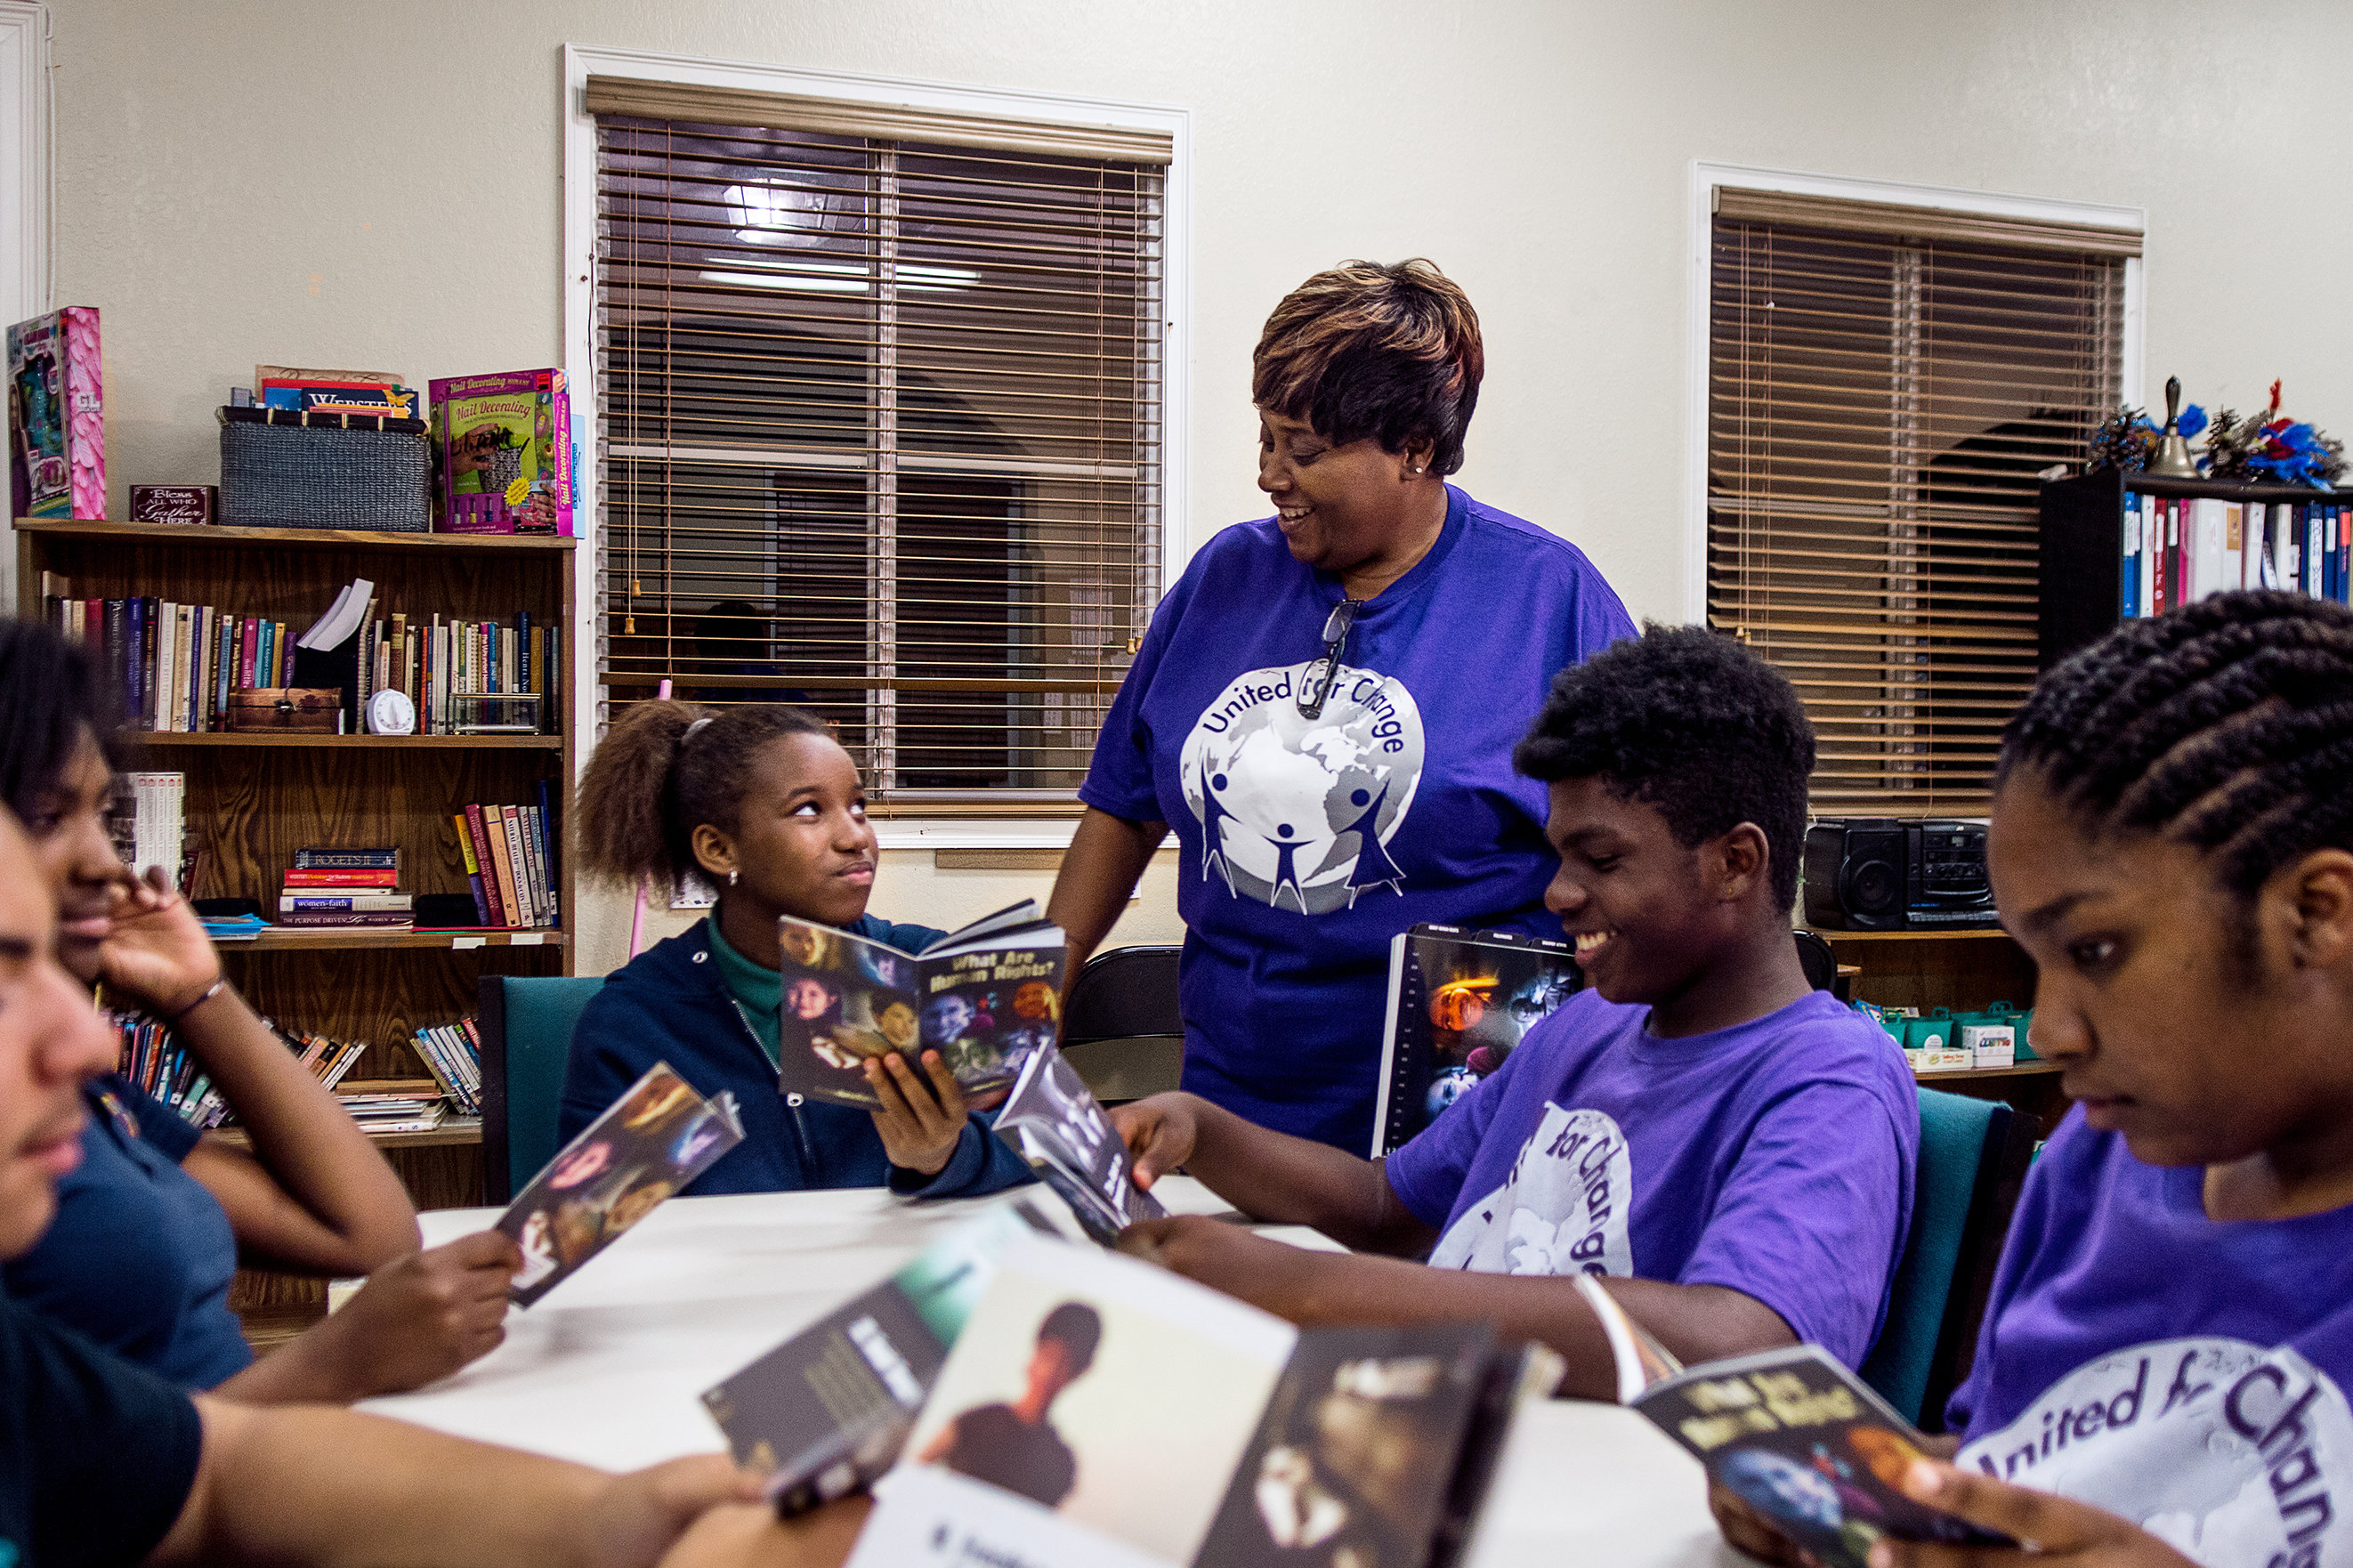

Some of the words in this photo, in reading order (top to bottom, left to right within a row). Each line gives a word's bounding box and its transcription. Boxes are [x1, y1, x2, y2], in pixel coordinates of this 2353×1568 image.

[450, 380, 465, 393] Nail
[467, 376, 505, 389] Decorating
[457, 403, 477, 421] Nail
[480, 400, 531, 418] Decorating
[558, 431, 567, 481] Decorating
[153, 489, 193, 498] Bless
[560, 483, 570, 505] Nail
[137, 504, 203, 520] Gather
[153, 516, 192, 524] HERE
[522, 652, 530, 675] Henri
[1202, 672, 1292, 733] United
[1351, 677, 1404, 754] Change
[508, 820, 517, 843] NATURAL
[522, 813, 530, 835] WATER
[511, 844, 520, 865] HEALTH
[1545, 1115, 1590, 1161] for
